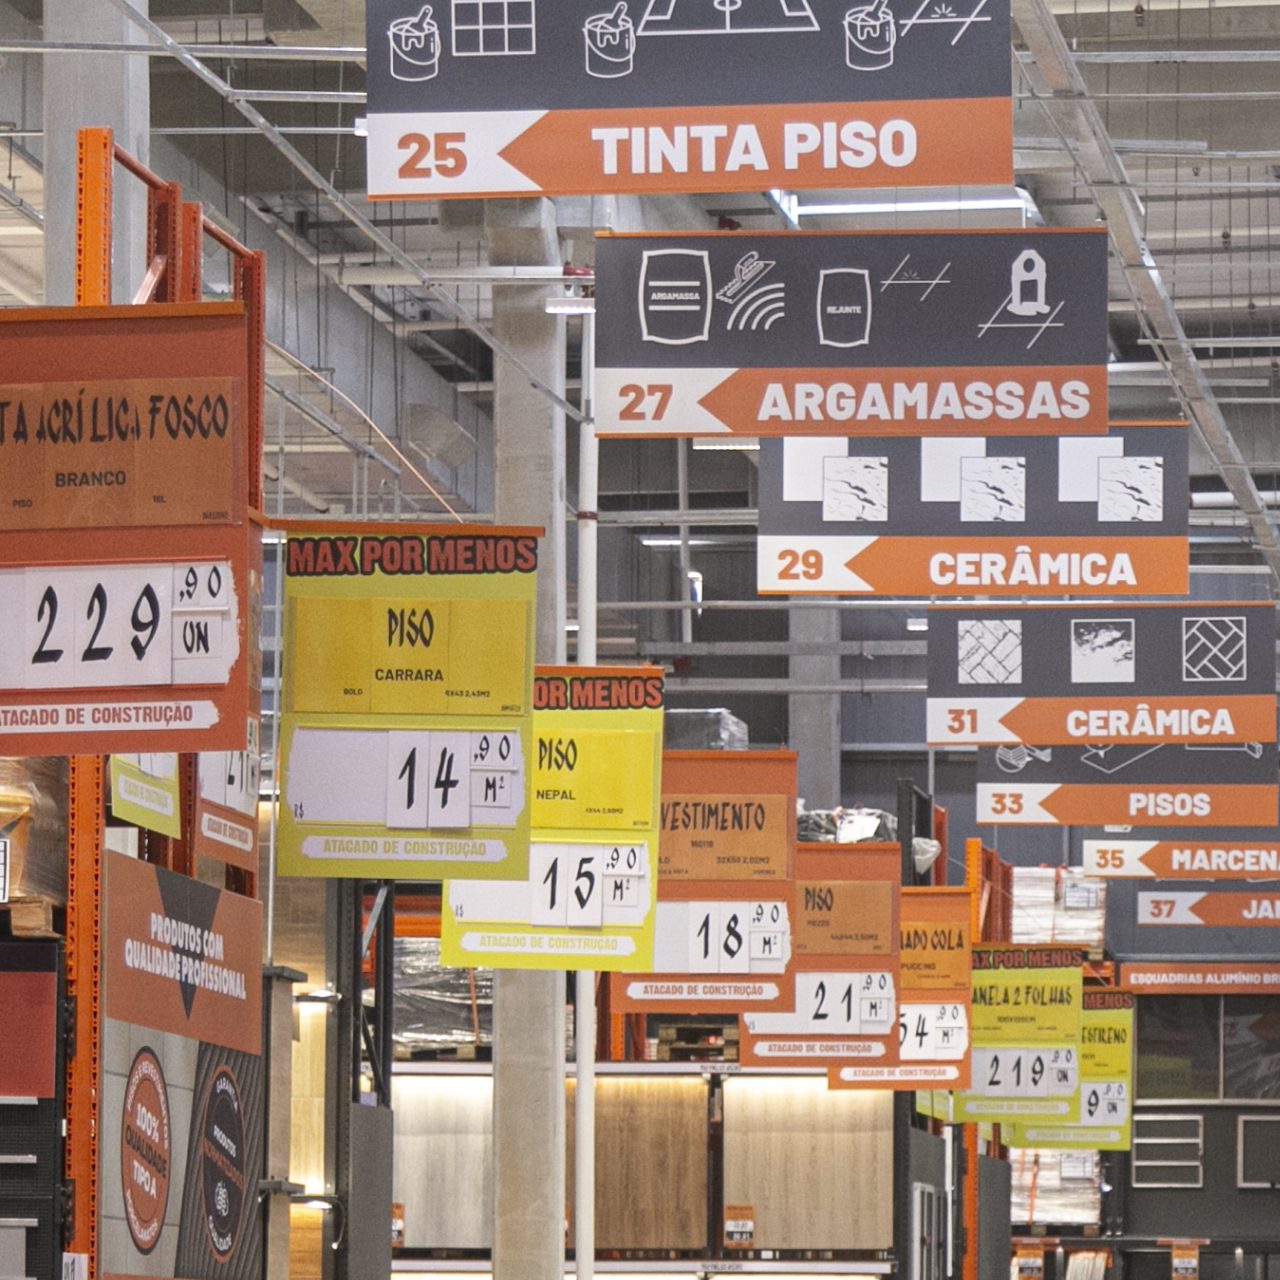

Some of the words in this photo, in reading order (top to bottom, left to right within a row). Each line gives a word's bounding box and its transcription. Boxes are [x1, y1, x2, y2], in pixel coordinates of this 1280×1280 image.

[397, 133, 468, 179] 25
[592, 125, 770, 175] TINTA
[784, 120, 917, 170] PISO
[651, 292, 700, 300] ARGAMASSA
[826, 306, 862, 314] REJUNTE
[149, 394, 229, 439] FOSCO
[618, 384, 673, 421] 27
[757, 380, 1091, 421] ARGAMASSAS
[55, 470, 127, 488] BRANCO
[286, 537, 358, 576] MAX
[361, 537, 427, 575] POR
[428, 536, 537, 574] MENOS
[777, 550, 823, 580] 29
[929, 545, 1137, 587] CERÂMICA
[32, 583, 160, 664] 229
[183, 620, 210, 654] UN
[388, 608, 434, 648] PISO
[375, 668, 444, 682] CARRARA
[571, 676, 664, 709] MENOS
[0, 707, 59, 726] TACADO
[66, 708, 85, 724] DE
[91, 703, 192, 727] CONSTRUÇÃO
[947, 709, 978, 734] 31
[1067, 703, 1235, 737] CERÂMICA
[538, 738, 577, 771] PISO
[398, 746, 459, 809] 14
[536, 789, 576, 800] NEPAL
[992, 793, 1023, 814] 33
[1129, 793, 1211, 817] PISOS
[323, 840, 378, 854] ATACADO
[383, 841, 399, 855] DE
[404, 841, 487, 858] CONSTRUÇÃO
[1096, 850, 1124, 869] 35
[543, 857, 595, 910] 15
[805, 887, 834, 911] PISO
[1150, 901, 1176, 918] 37
[151, 912, 202, 953] PRODUTOS
[202, 929, 224, 961] COM
[480, 935, 527, 948] ATACADO
[530, 936, 544, 948] DE
[697, 913, 743, 959] 18
[931, 929, 964, 950] COLA
[125, 938, 181, 981] QUALIDADE
[181, 954, 247, 1000] PROFISSIONAL
[994, 950, 1025, 969] POR
[1027, 949, 1083, 969] MENOS
[643, 985, 684, 996] ATACADO
[687, 985, 699, 996] DE
[702, 984, 764, 998] CONSTRUÇÃO
[1130, 973, 1203, 985] ESQUADRIAS
[1206, 971, 1261, 985] ALUMÍNIO
[812, 981, 853, 1022] 21
[1024, 984, 1073, 1006] FOLHAS
[768, 1043, 803, 1053] ATACADO
[806, 1044, 816, 1053] DE
[988, 1054, 1044, 1087] 219
[136, 1103, 159, 1143] 100%
[126, 1124, 167, 1179] QUALIDADE
[214, 1125, 237, 1158] PRODUTOS
[133, 1160, 150, 1193] TIPO
[150, 1177, 157, 1199] A
